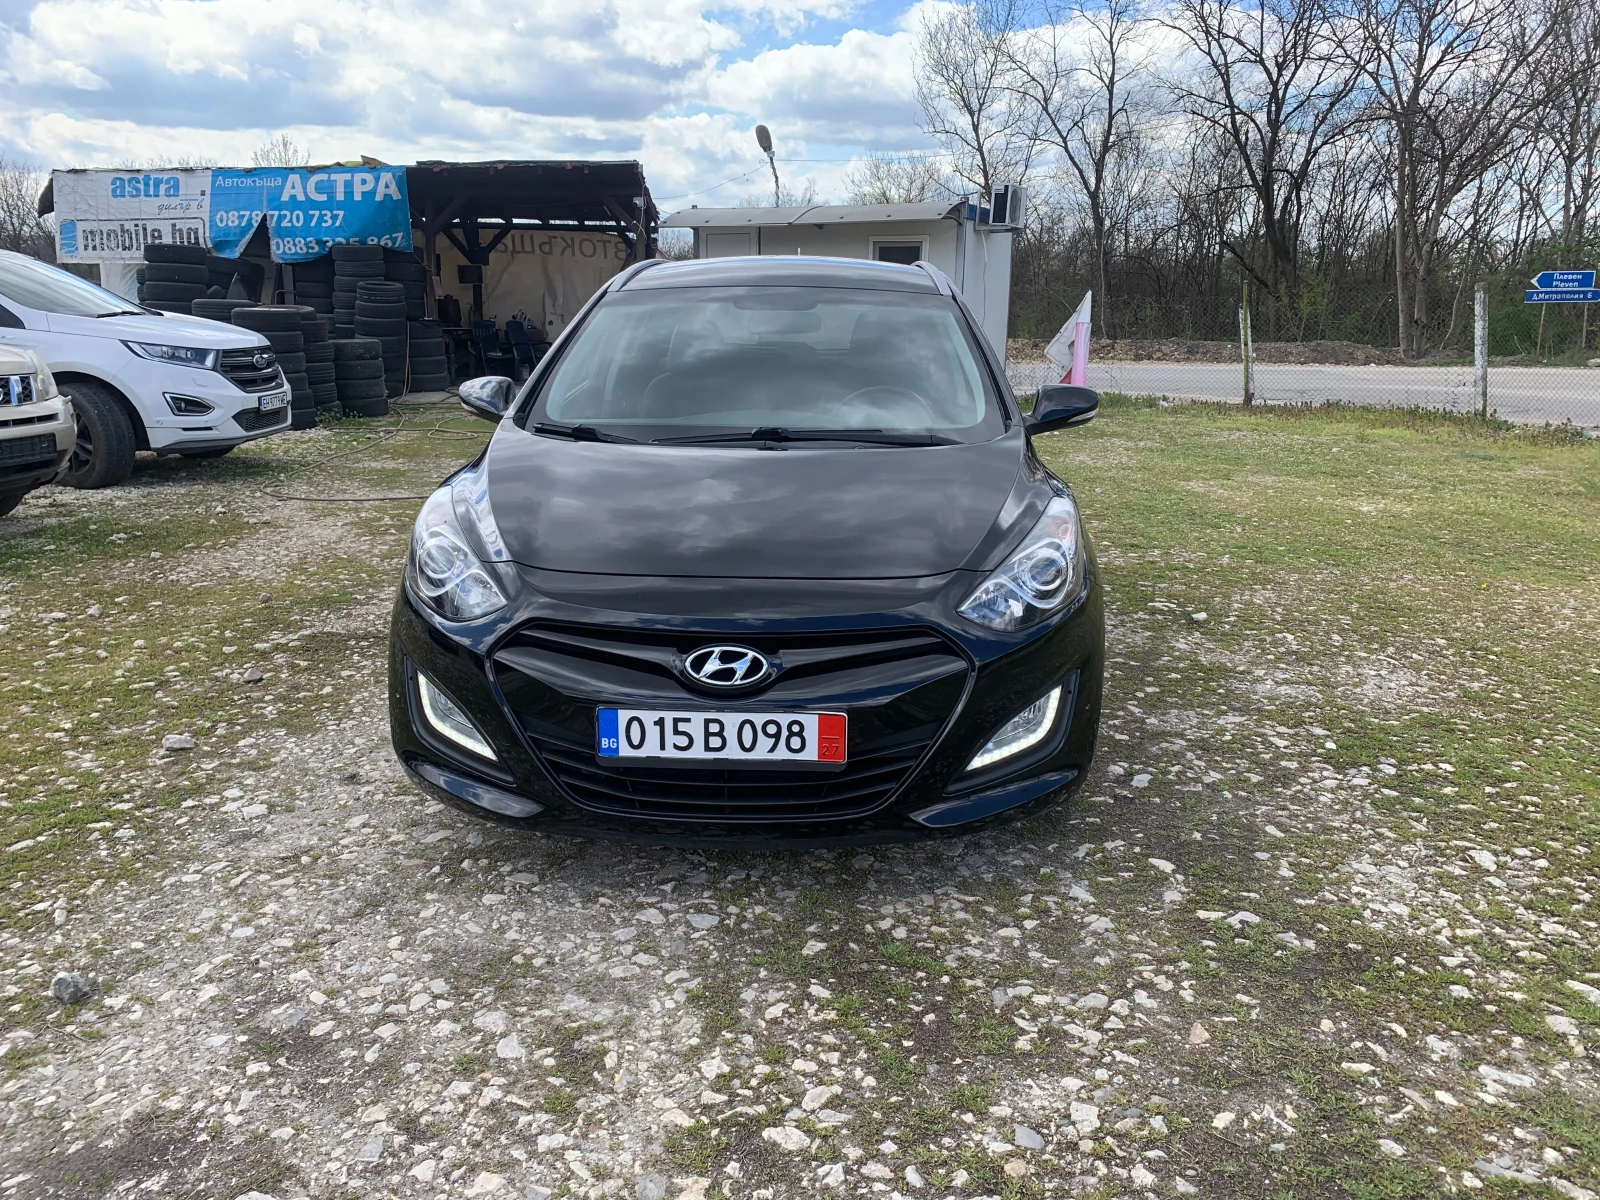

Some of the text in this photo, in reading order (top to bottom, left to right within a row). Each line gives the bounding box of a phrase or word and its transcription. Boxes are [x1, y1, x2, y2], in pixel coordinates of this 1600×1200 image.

[110, 174, 180, 198] astra
[215, 174, 282, 188] Автокъща
[281, 172, 402, 201] АСТРА
[216, 210, 345, 227] 0878 720 737
[274, 237, 319, 255] 0883
[601, 738, 617, 748] BG
[821, 744, 840, 756] 27
